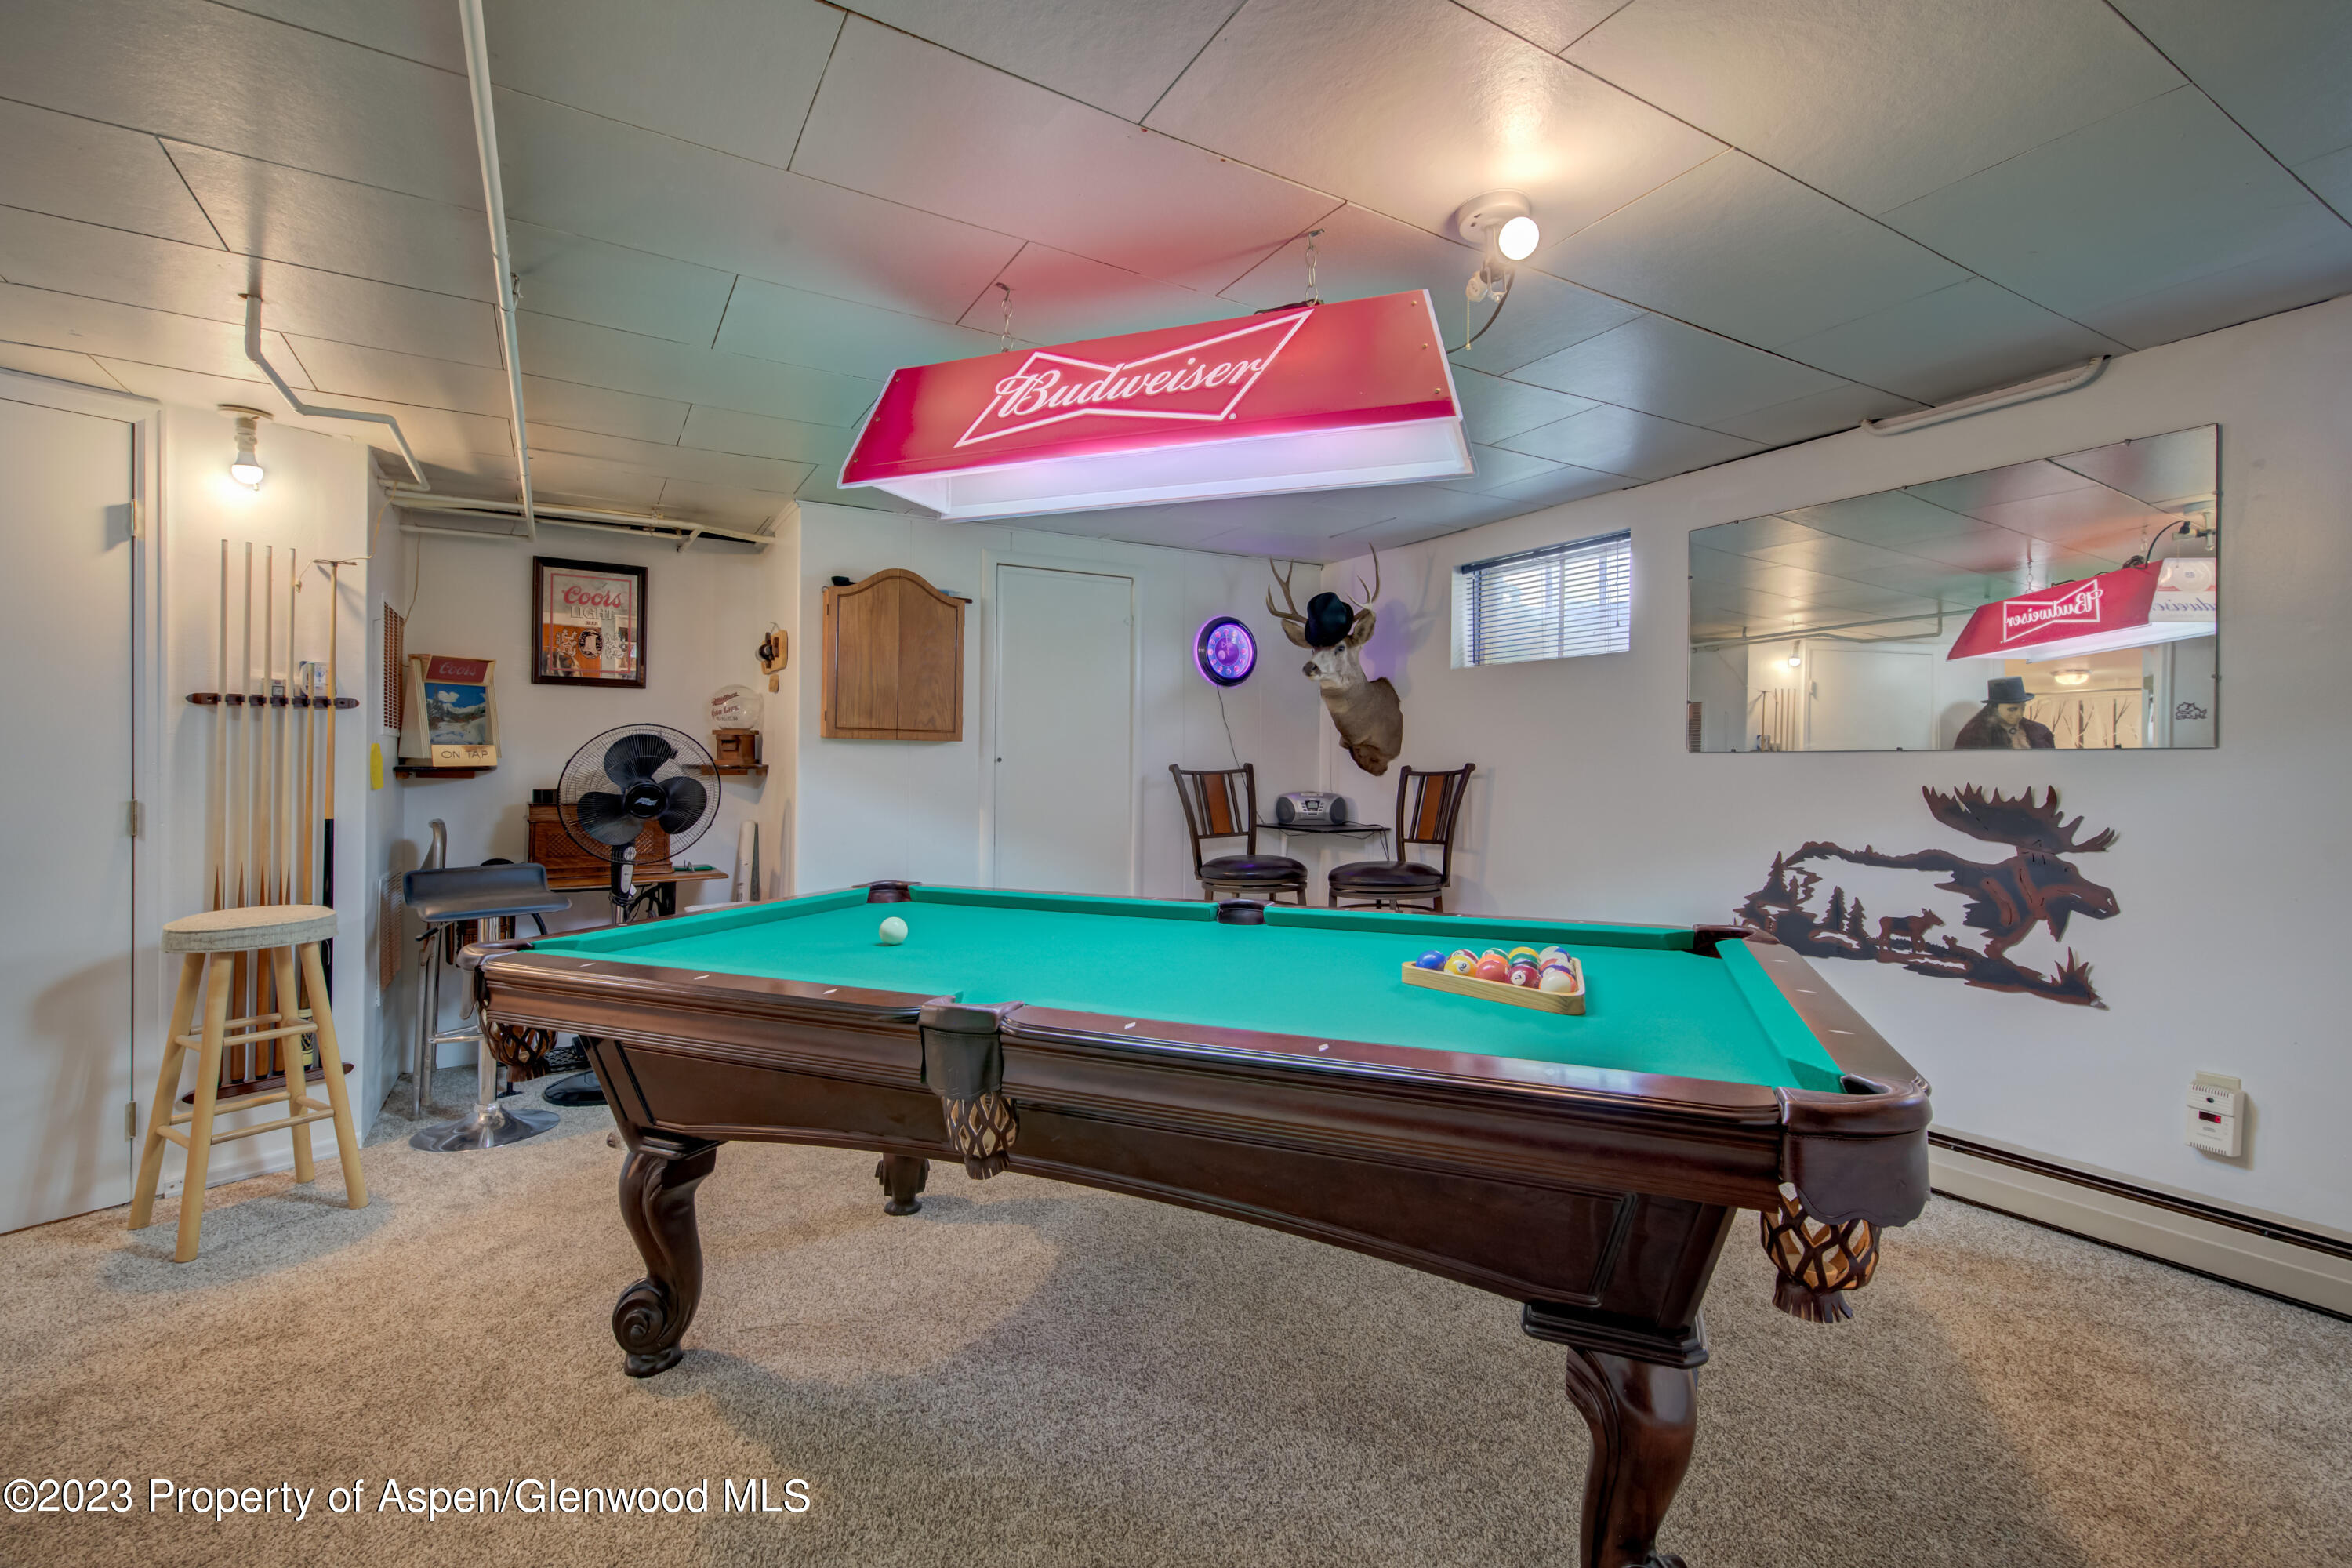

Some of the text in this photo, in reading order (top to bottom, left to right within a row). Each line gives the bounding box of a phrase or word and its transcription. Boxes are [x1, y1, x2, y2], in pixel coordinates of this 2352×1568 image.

[996, 357, 1263, 418] Budweiser
[561, 585, 622, 608] Coors
[570, 605, 615, 621] LIGHT
[438, 661, 477, 677] Coors
[441, 750, 489, 760] ON TAP
